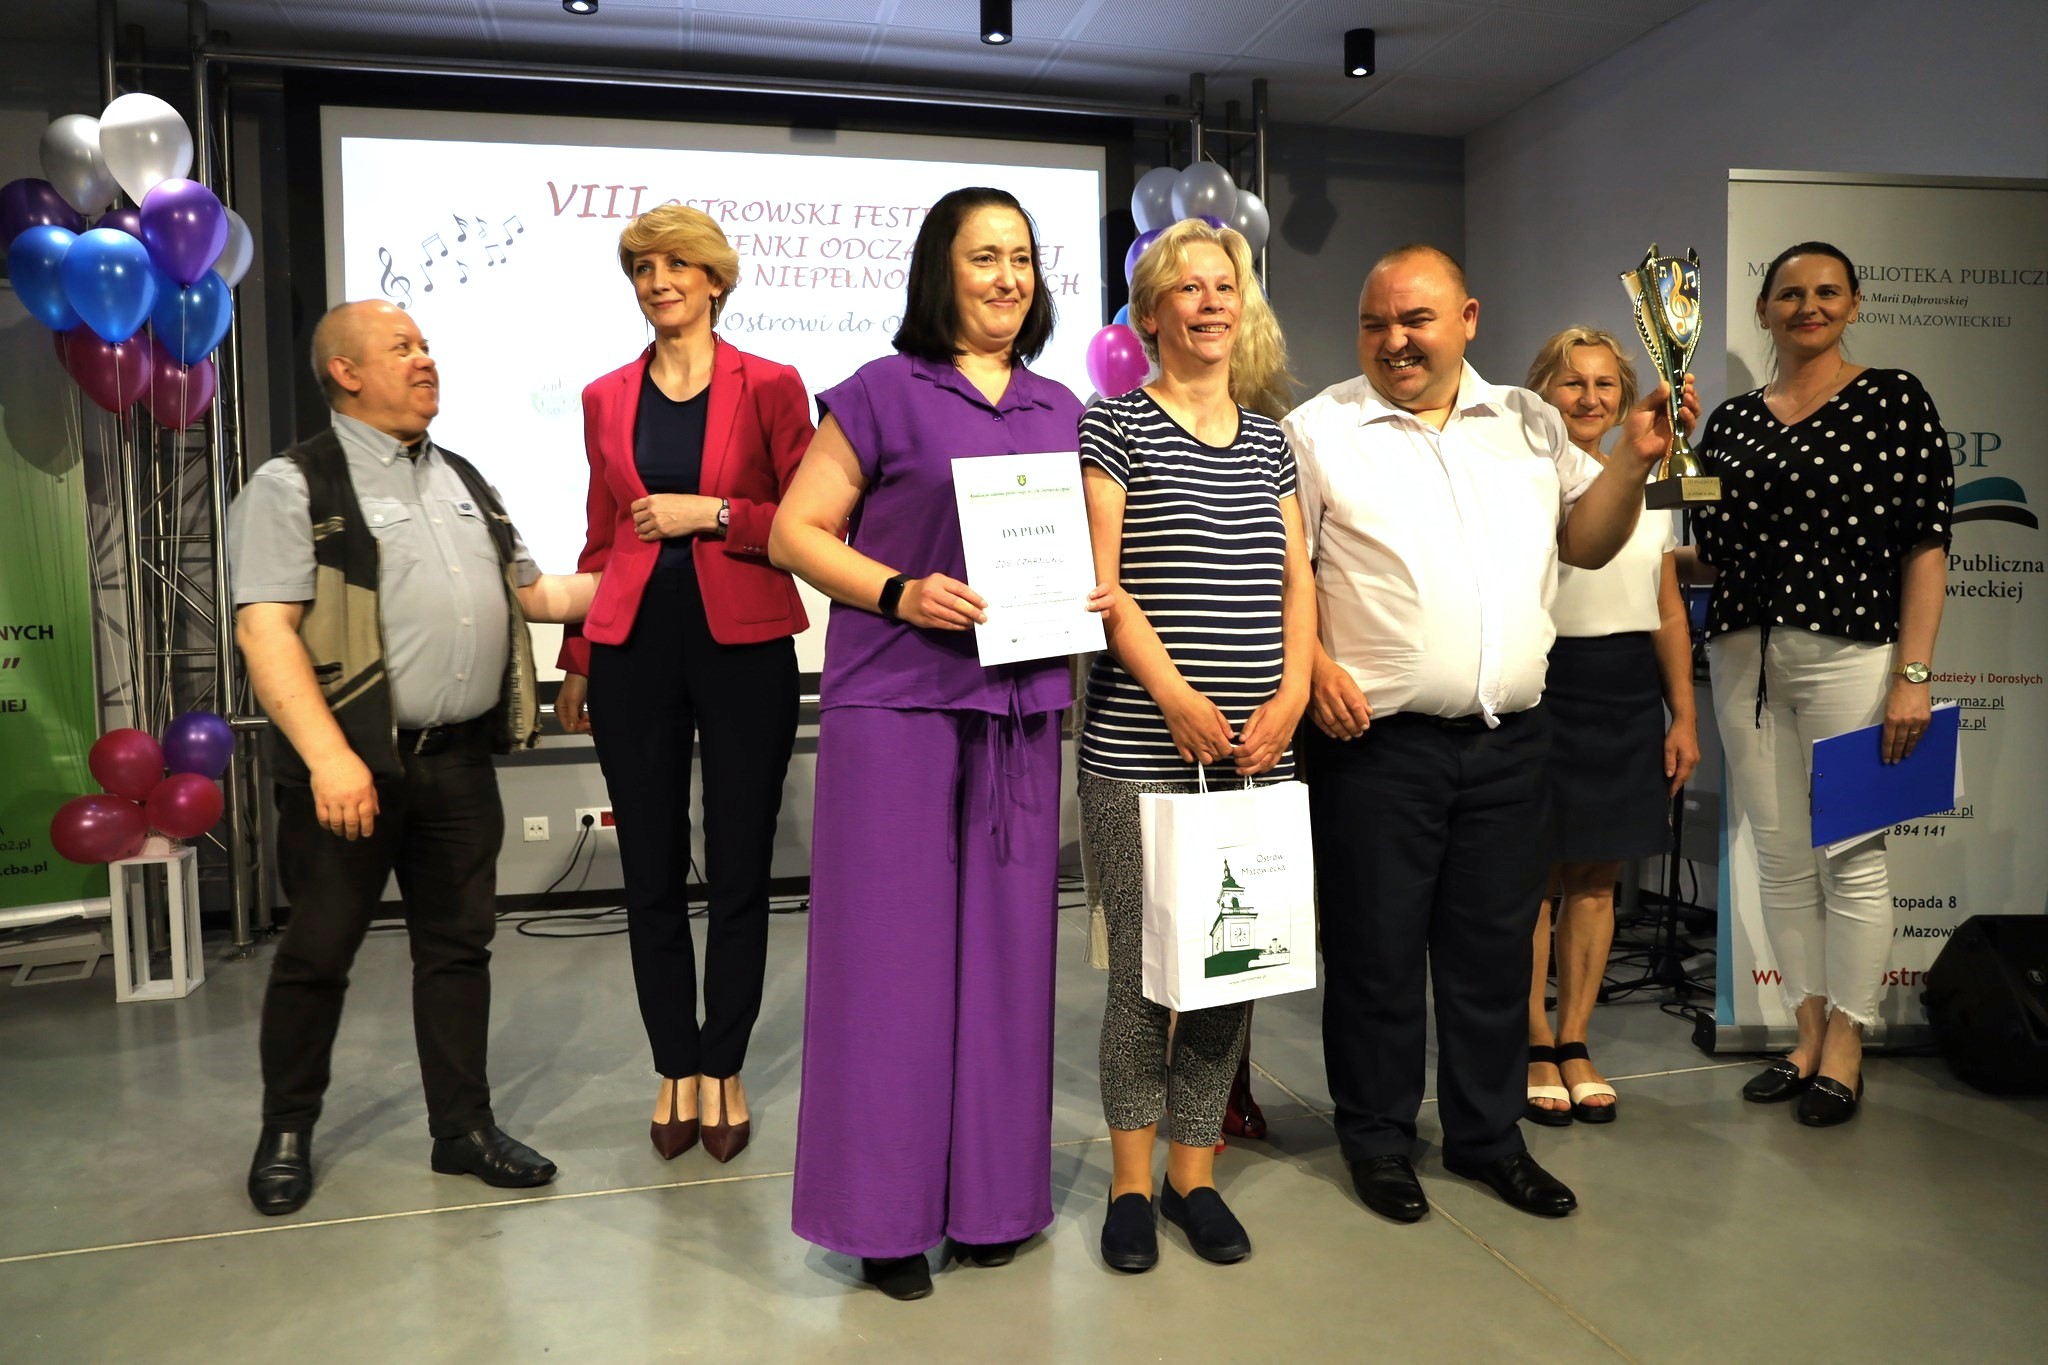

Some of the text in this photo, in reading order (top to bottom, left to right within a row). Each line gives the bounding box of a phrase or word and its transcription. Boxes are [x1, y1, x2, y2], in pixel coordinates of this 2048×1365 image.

[547, 181, 648, 219] VIII
[667, 198, 842, 225] TROWSKI
[726, 233, 809, 259] ENKI
[1856, 265, 2048, 286] BLIOTEKA PUBLICZ
[1870, 292, 1900, 304] Marii
[1902, 294, 1968, 308] Dąbrowskiej
[724, 312, 833, 333] Ostrowi
[838, 312, 876, 333] do
[1857, 311, 2011, 328] ROWI MAZOWIECKIEJ
[1946, 432, 2002, 467] BP
[1002, 525, 1055, 539] DYPLOM
[1948, 554, 2044, 573] Publiczna
[1945, 580, 2023, 603] wieckiej
[1930, 672, 2043, 686] odzieży i Dorosłych
[0, 698, 27, 713] IEJ
[1894, 824, 1919, 836] 894
[1923, 824, 1946, 836] 141
[1893, 896, 1957, 911] topada 8
